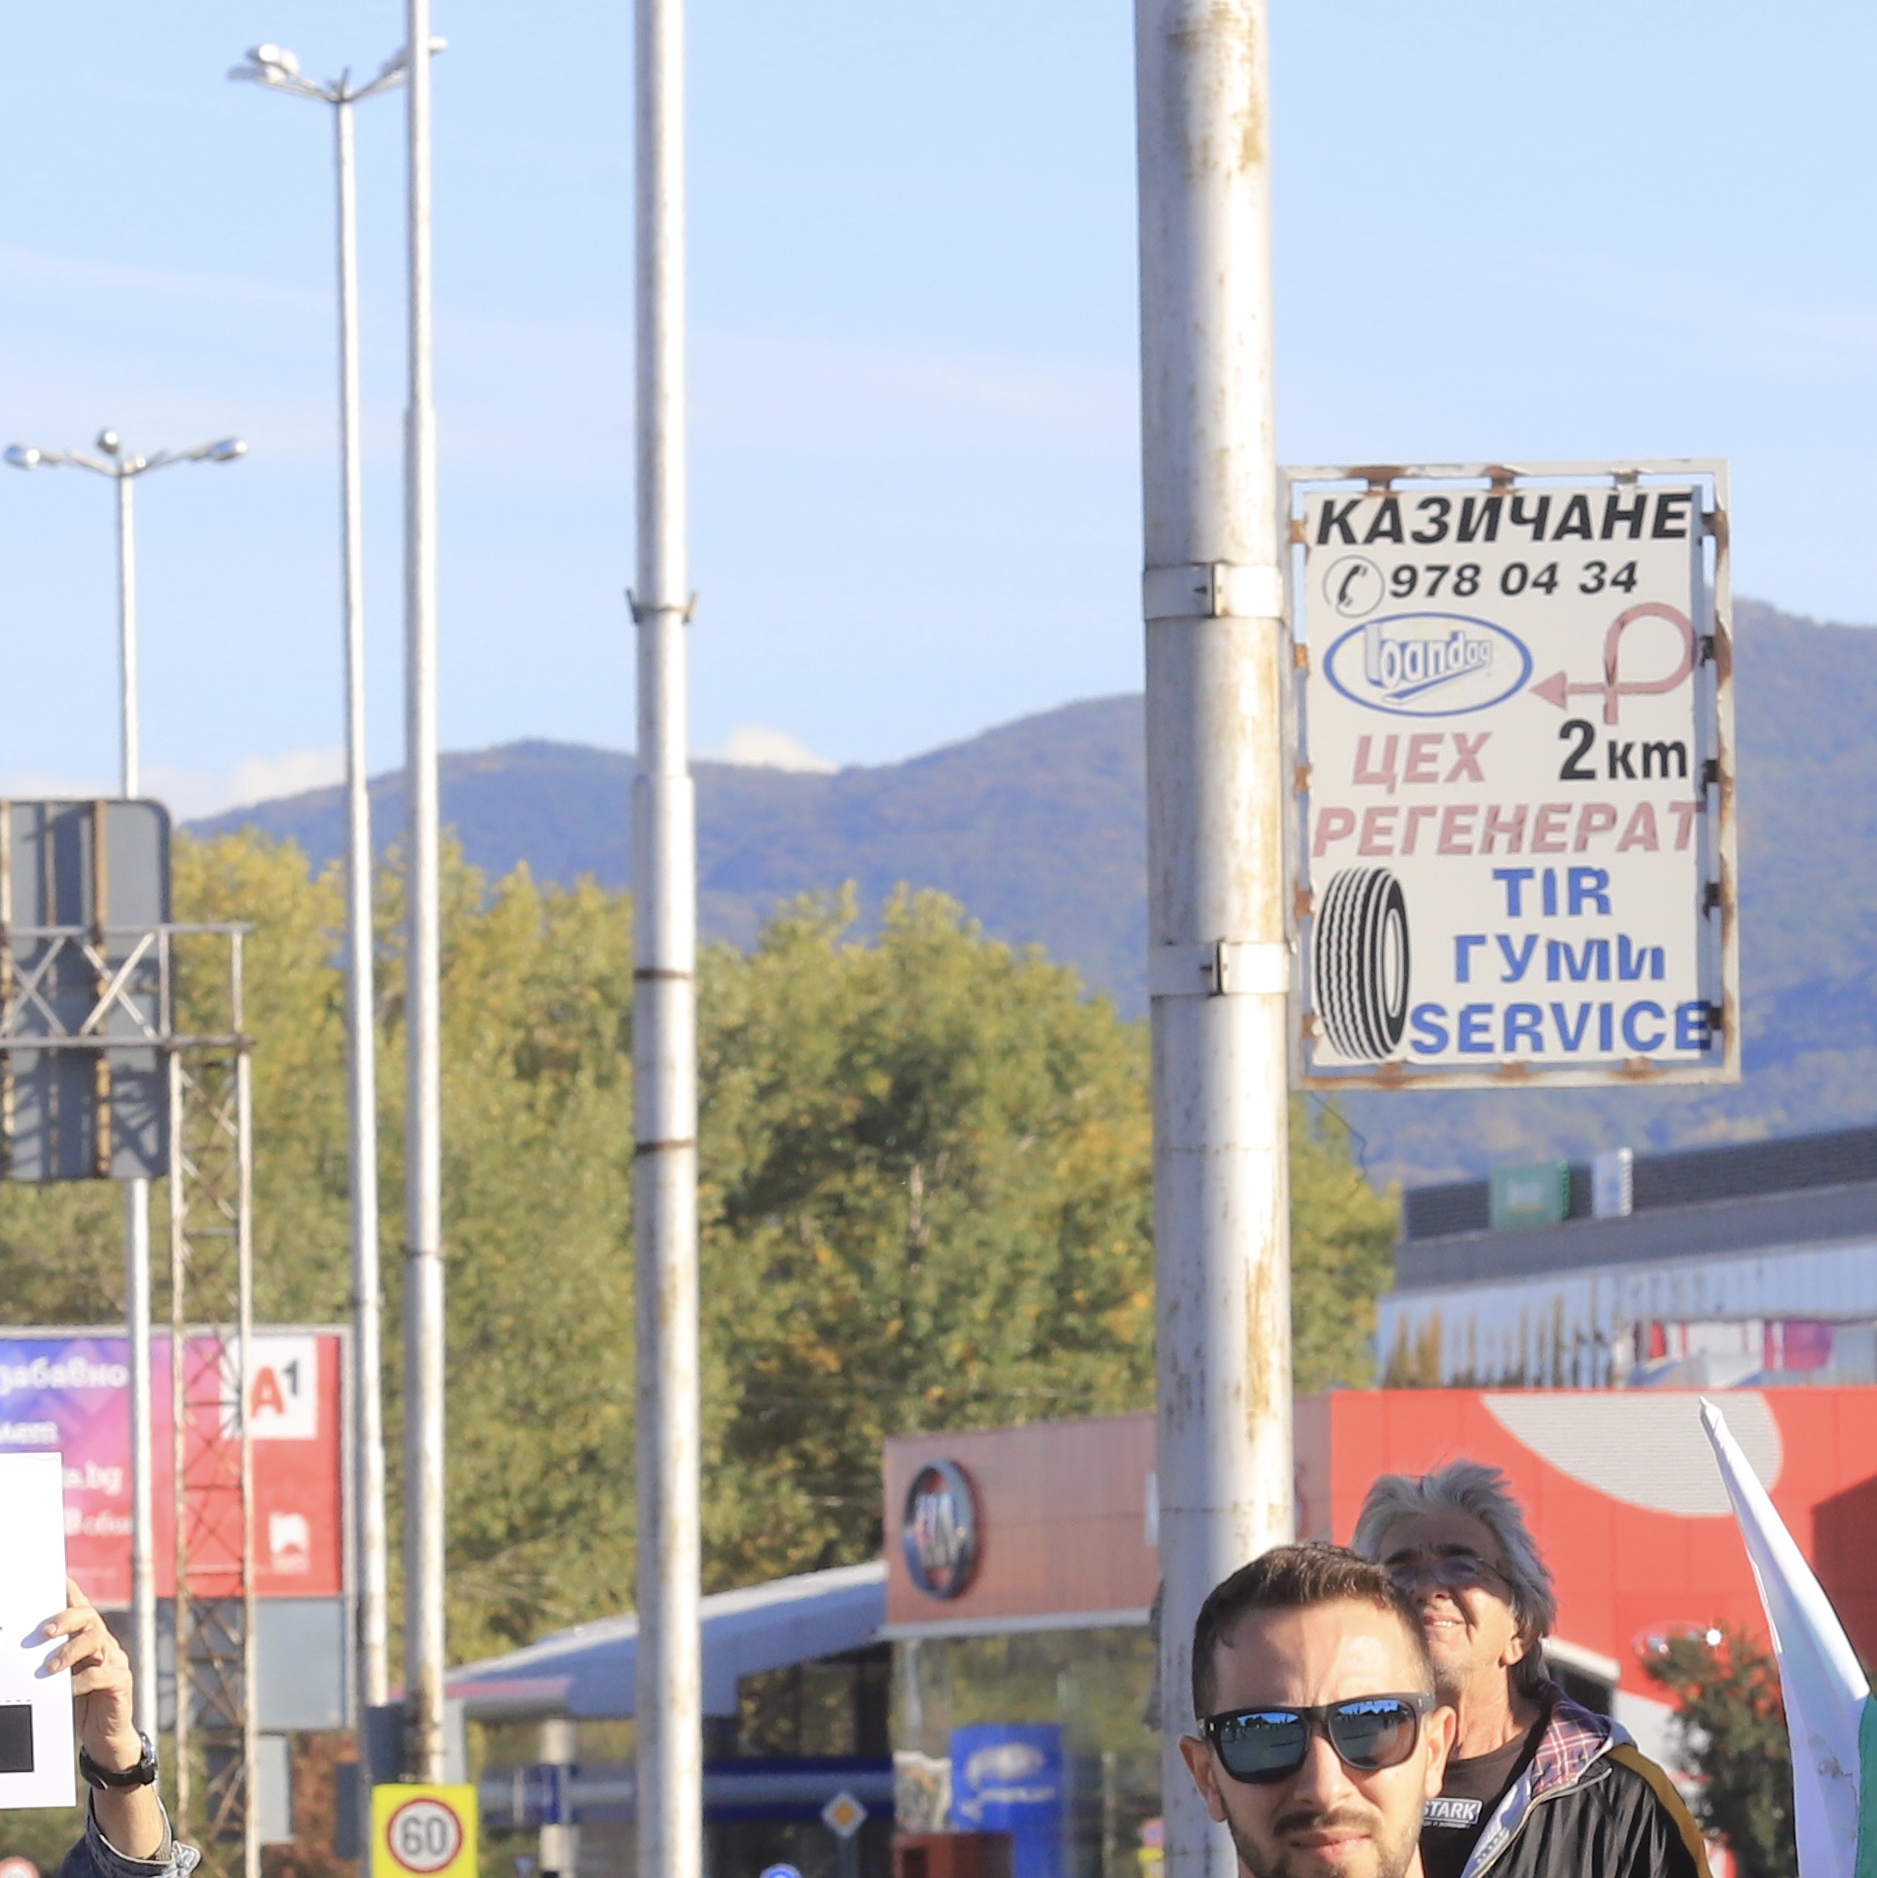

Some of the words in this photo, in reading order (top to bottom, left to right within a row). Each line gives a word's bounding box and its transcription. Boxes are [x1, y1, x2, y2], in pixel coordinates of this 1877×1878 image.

[1315, 493, 1694, 546] КАЗИЧАНЕ
[1389, 562, 1480, 599] 978
[1500, 561, 1559, 597] 04
[1579, 559, 1638, 595] 34
[1352, 731, 1492, 795] ЦЕХ
[1558, 719, 1596, 781] 2
[1608, 739, 1687, 781] km
[1312, 801, 1707, 857] РЕГЕНЕРАТ
[1493, 867, 1611, 917] TIR
[1454, 933, 1664, 983] ГУМИ
[1409, 999, 1713, 1055] SERVICE
[250, 1358, 298, 1419] A1
[401, 1815, 447, 1856] 60
